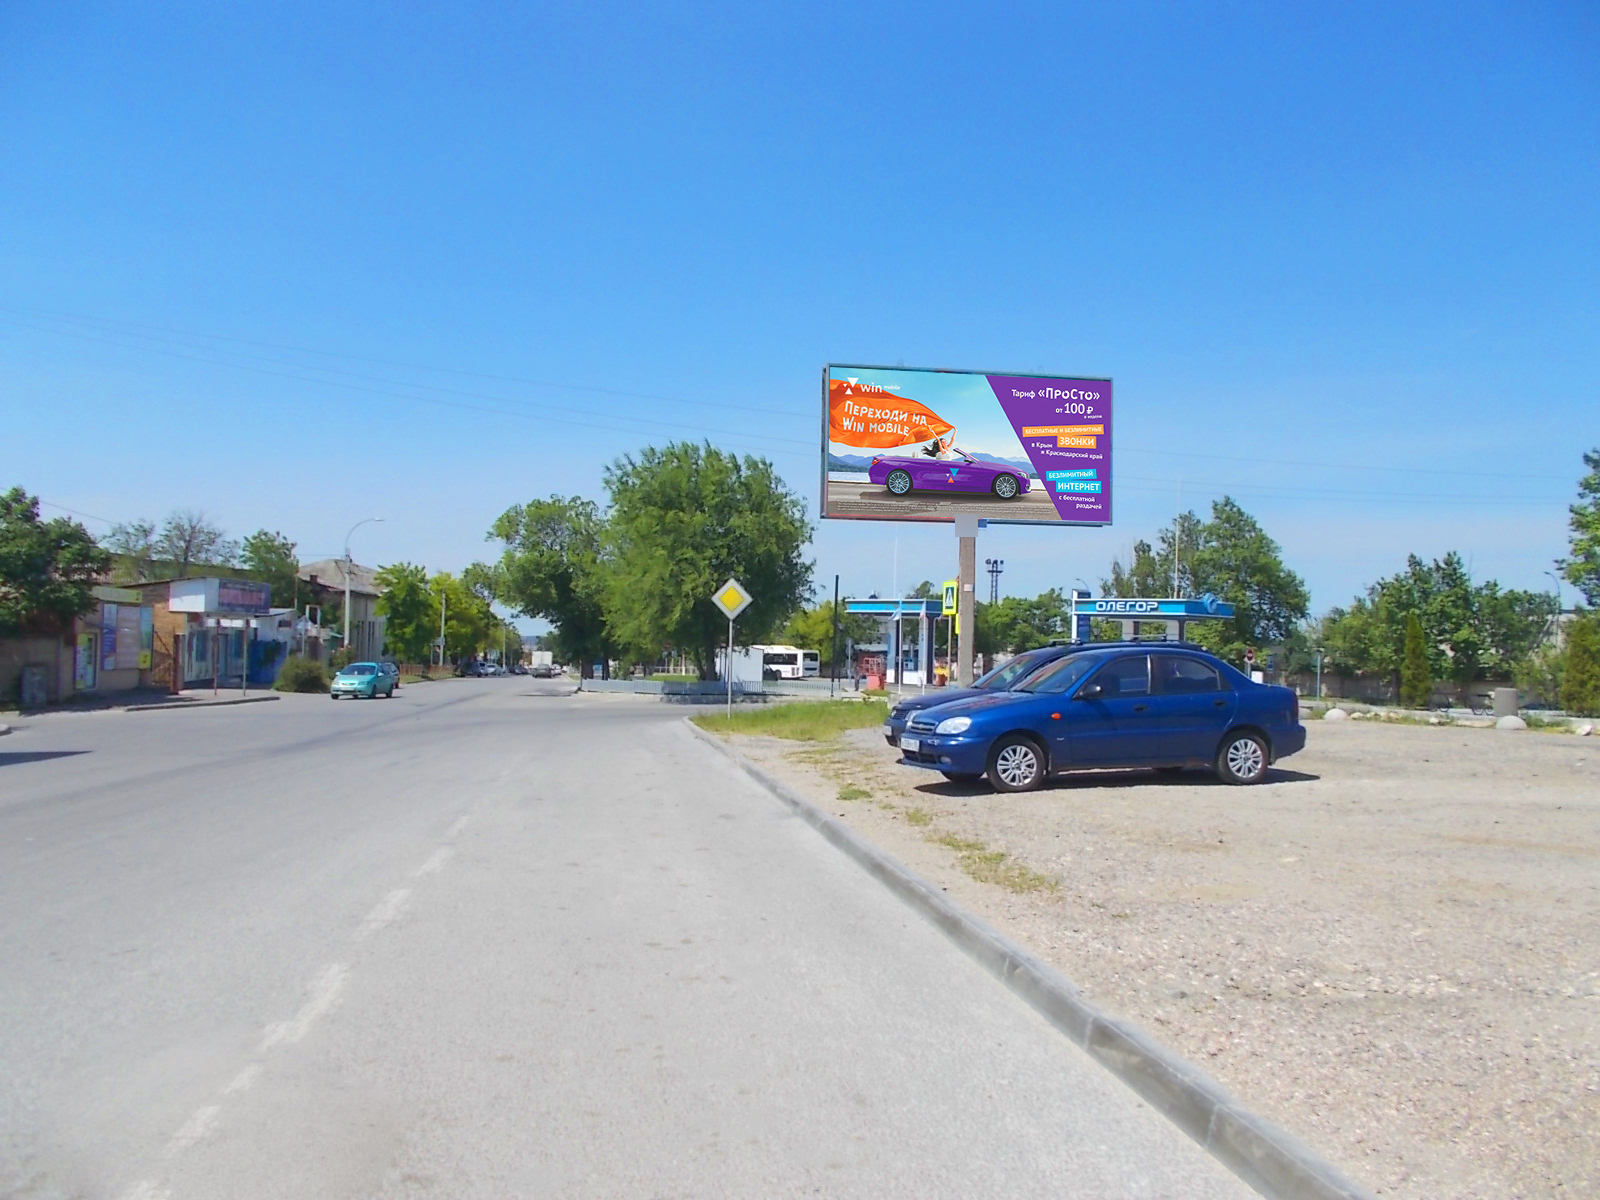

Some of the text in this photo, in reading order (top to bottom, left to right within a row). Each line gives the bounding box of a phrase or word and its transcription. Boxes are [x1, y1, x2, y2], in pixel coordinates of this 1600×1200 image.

[860, 382, 882, 393] win
[1011, 389, 1036, 399] Тариф
[1064, 403, 1085, 414] 100
[1060, 437, 1094, 446] ЗВОНКИ
[1046, 450, 1088, 458] Краснодарский
[1049, 470, 1093, 478] БЕЗЛИМИТНЫЙ
[1058, 482, 1100, 491] ИНТЕРНЕТ
[1096, 601, 1158, 612] ОЛЕГОР
